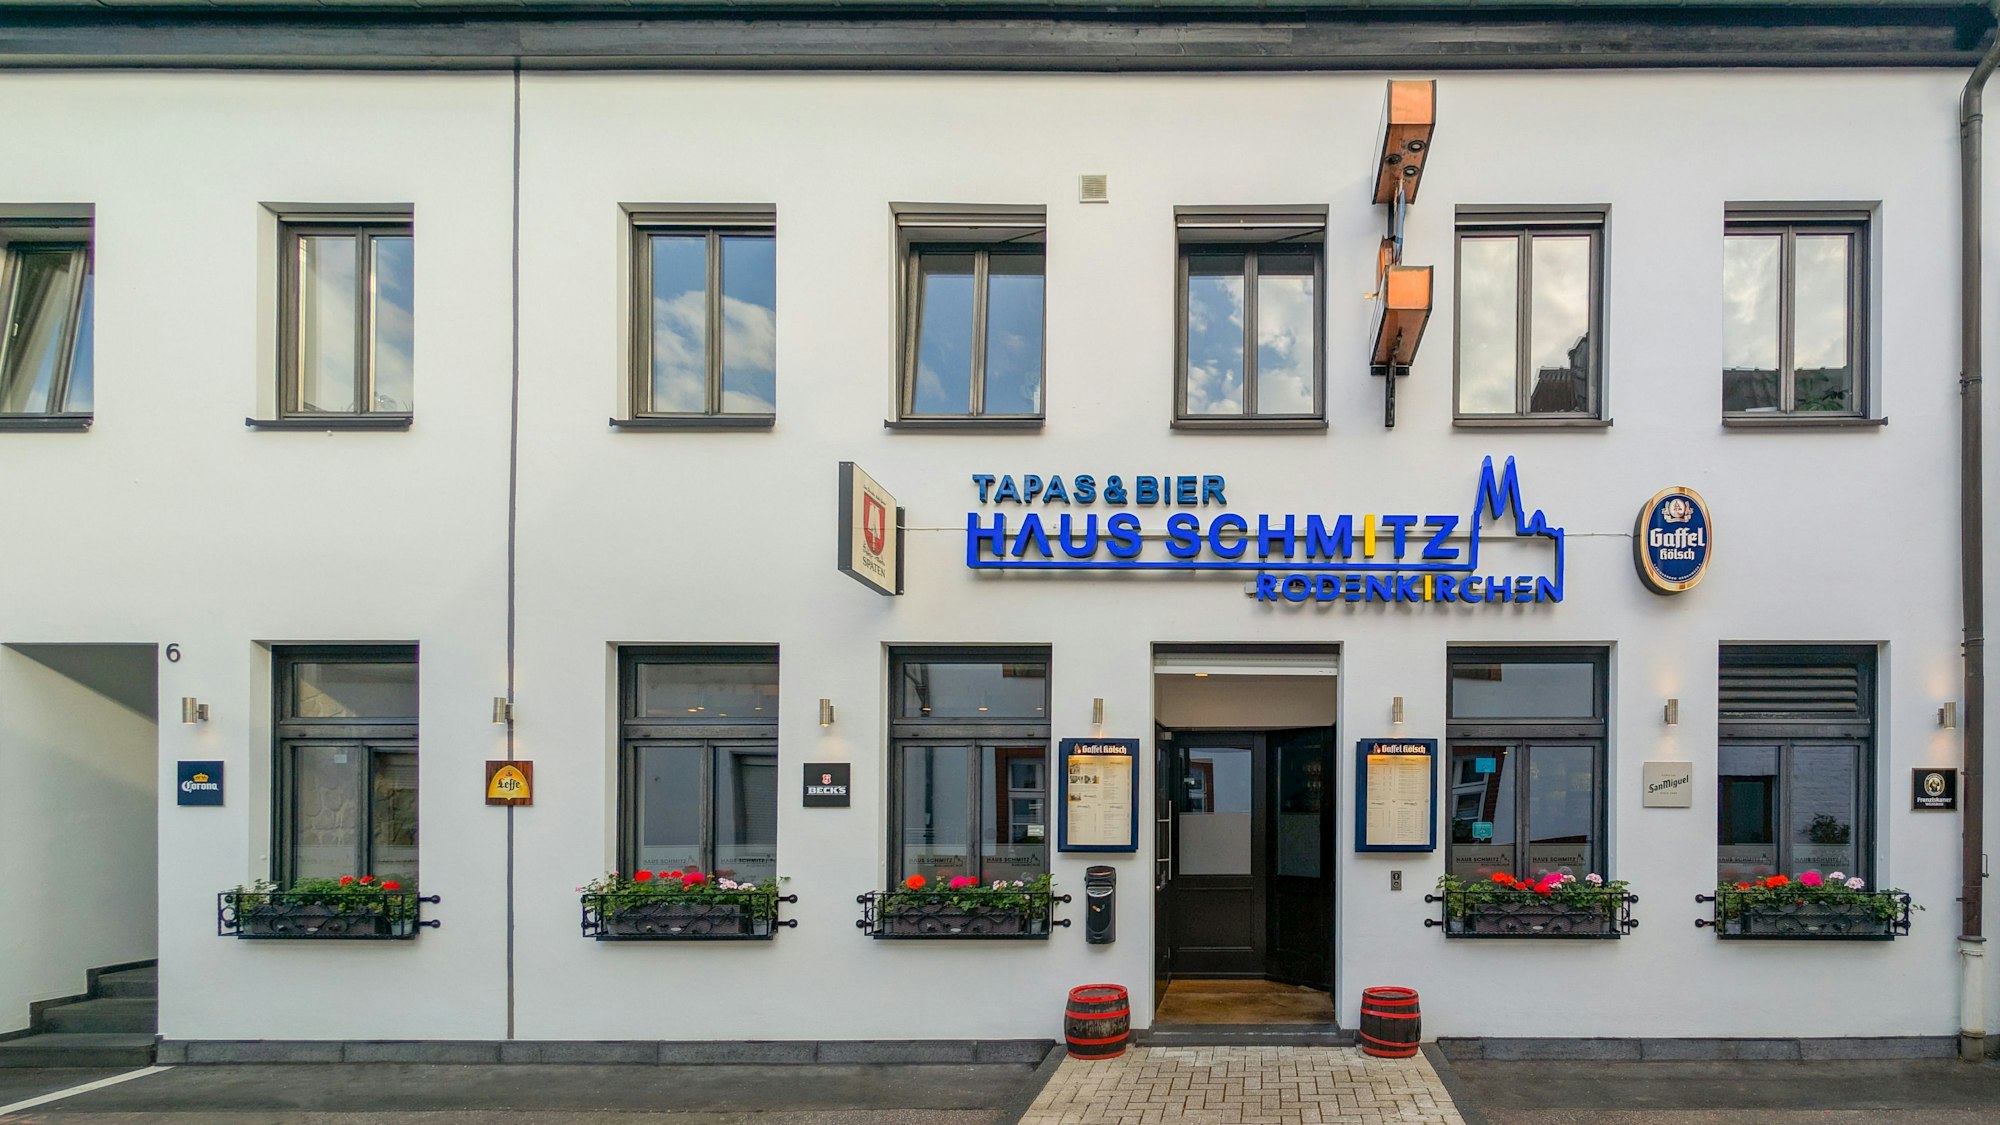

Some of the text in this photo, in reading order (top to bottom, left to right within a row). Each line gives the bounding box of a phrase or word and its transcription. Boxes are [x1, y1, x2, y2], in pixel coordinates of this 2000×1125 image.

[967, 512, 1460, 560] HAUS SCHMITZ
[1649, 527, 1706, 549] Gaffel
[1659, 547, 1696, 561] Kölsch
[862, 556, 886, 578] SPATEN
[1256, 573, 1563, 603] RODENKIRCHEN
[166, 643, 181, 663] 6
[1082, 744, 1127, 755] Gaffel Kölsch
[1381, 743, 1426, 754] Gaffel Kölsch
[181, 780, 219, 793] Corona
[497, 778, 522, 792] Leffe
[808, 785, 846, 794] BECK'S
